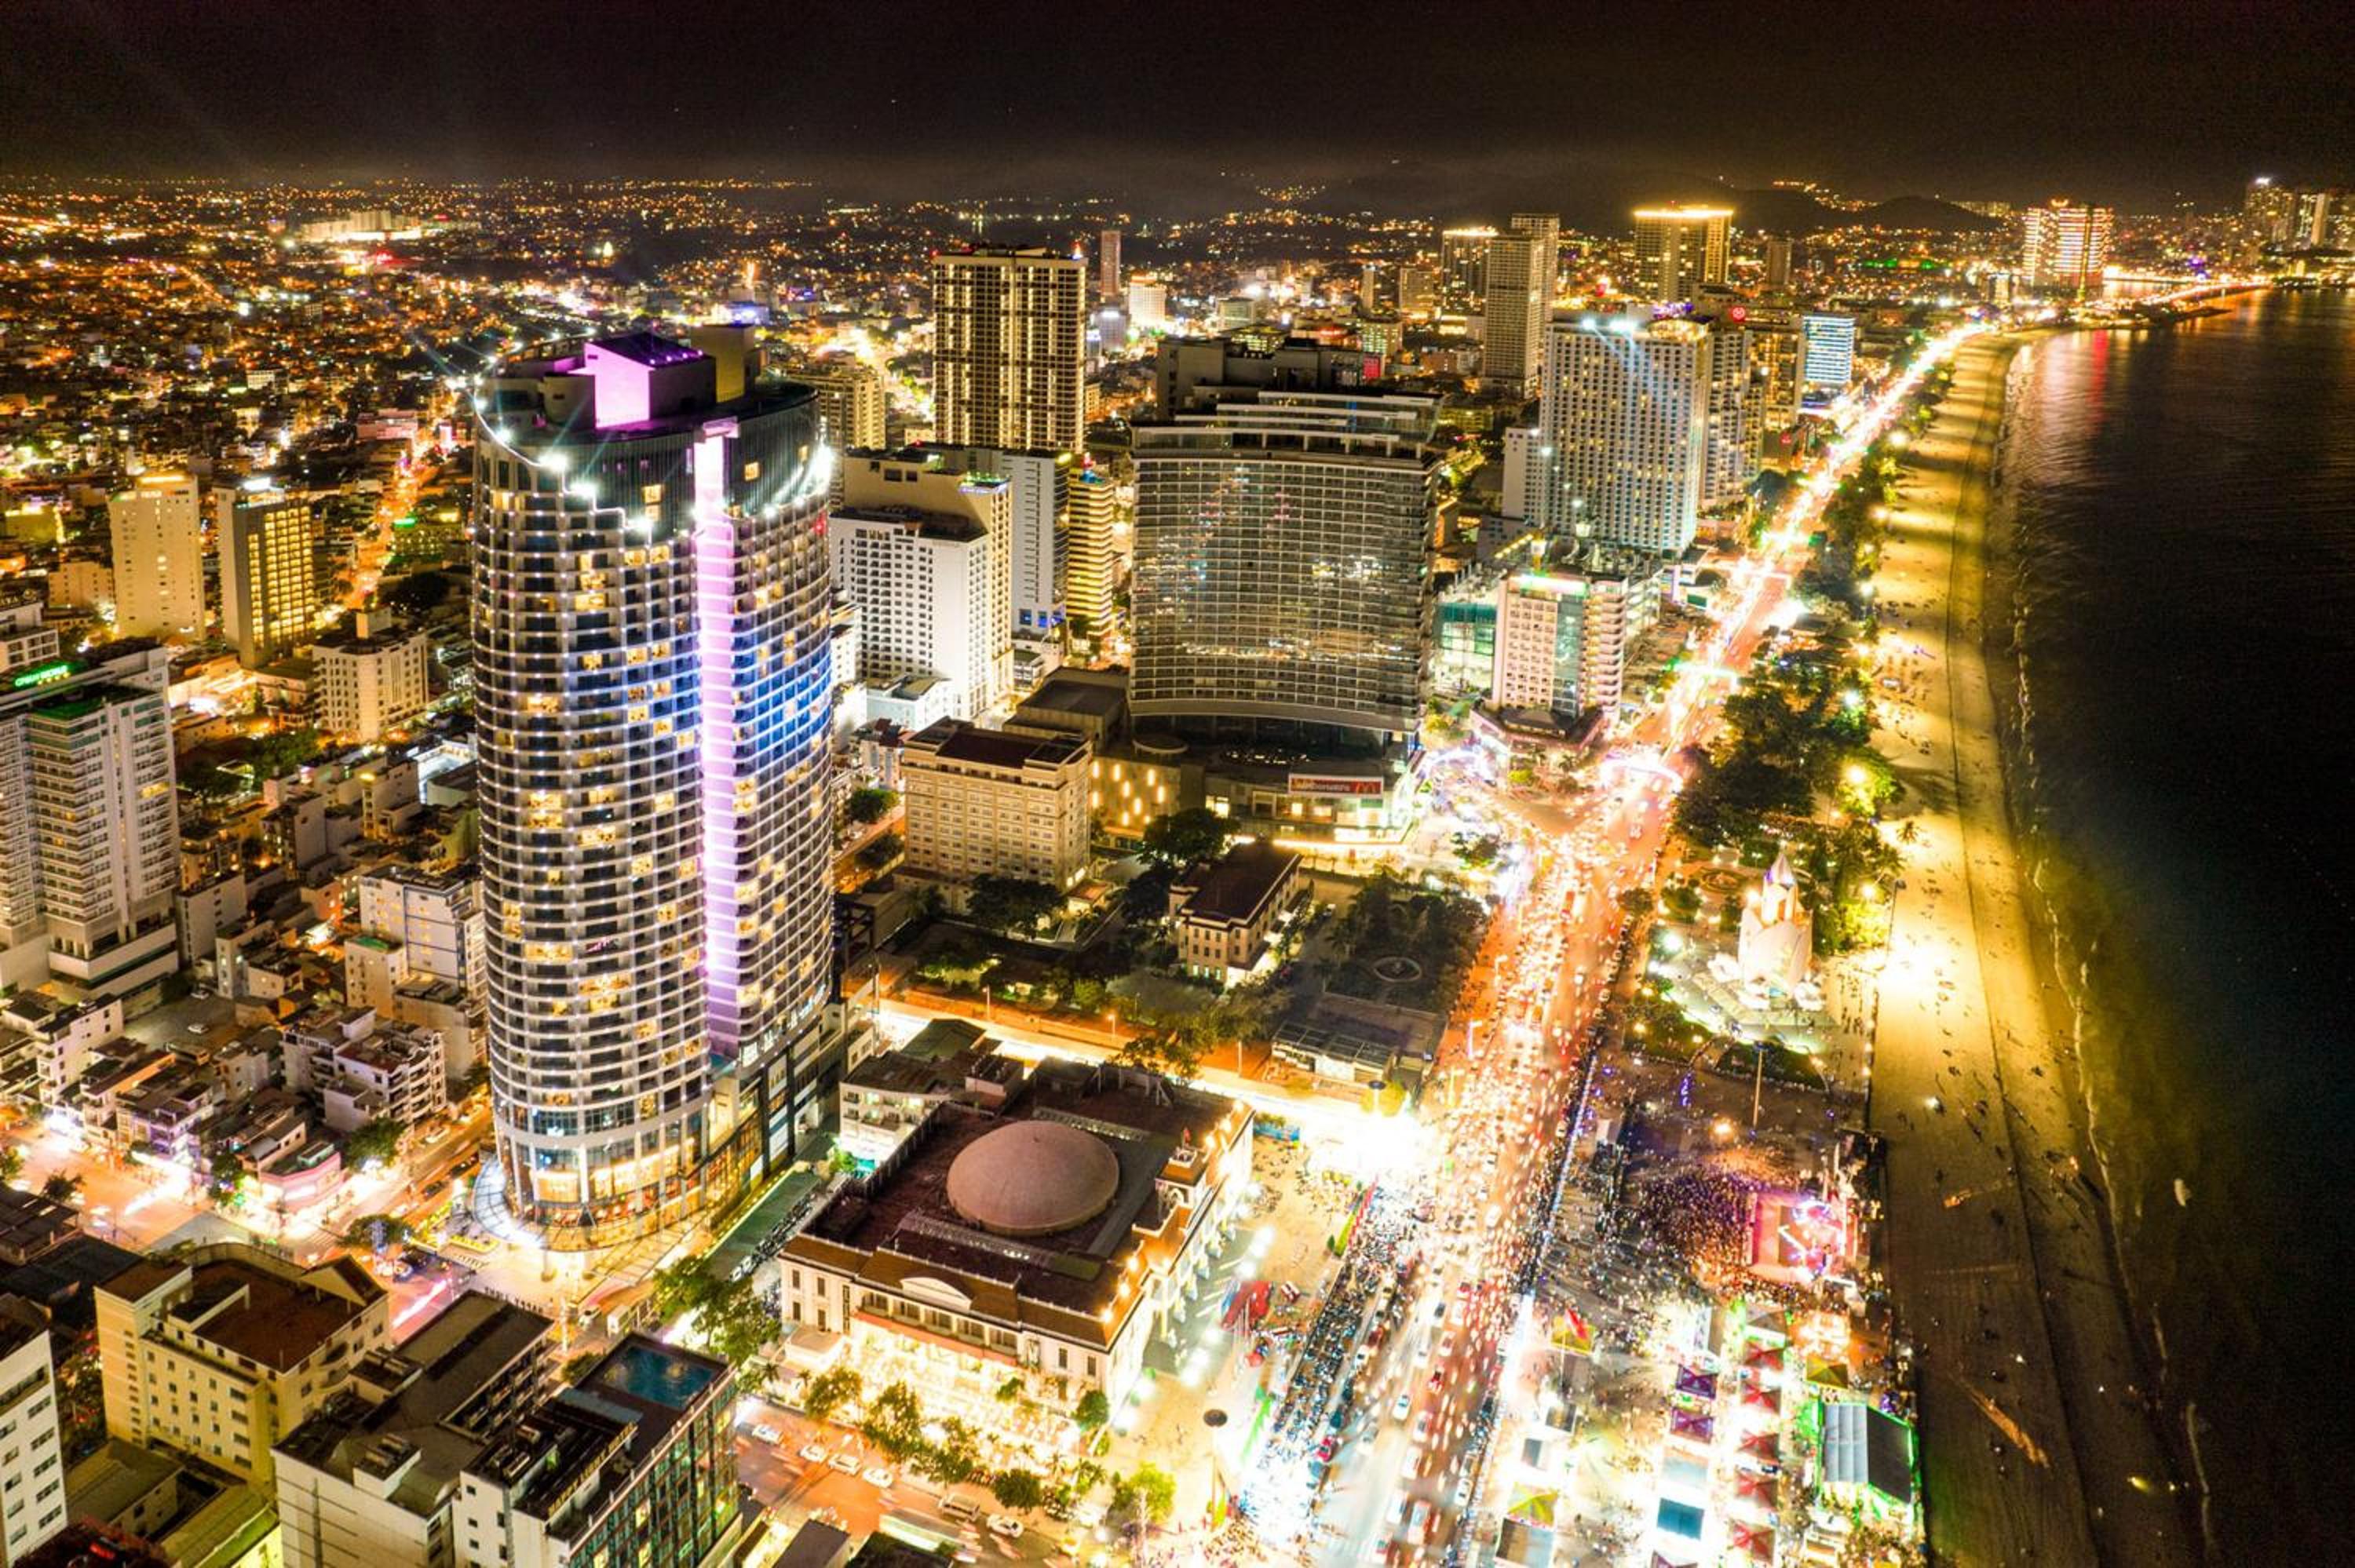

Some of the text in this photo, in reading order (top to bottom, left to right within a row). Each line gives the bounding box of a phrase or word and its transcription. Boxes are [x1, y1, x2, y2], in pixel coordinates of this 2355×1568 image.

[548, 1421, 634, 1517] HAPPY LIGHT HOTEL
